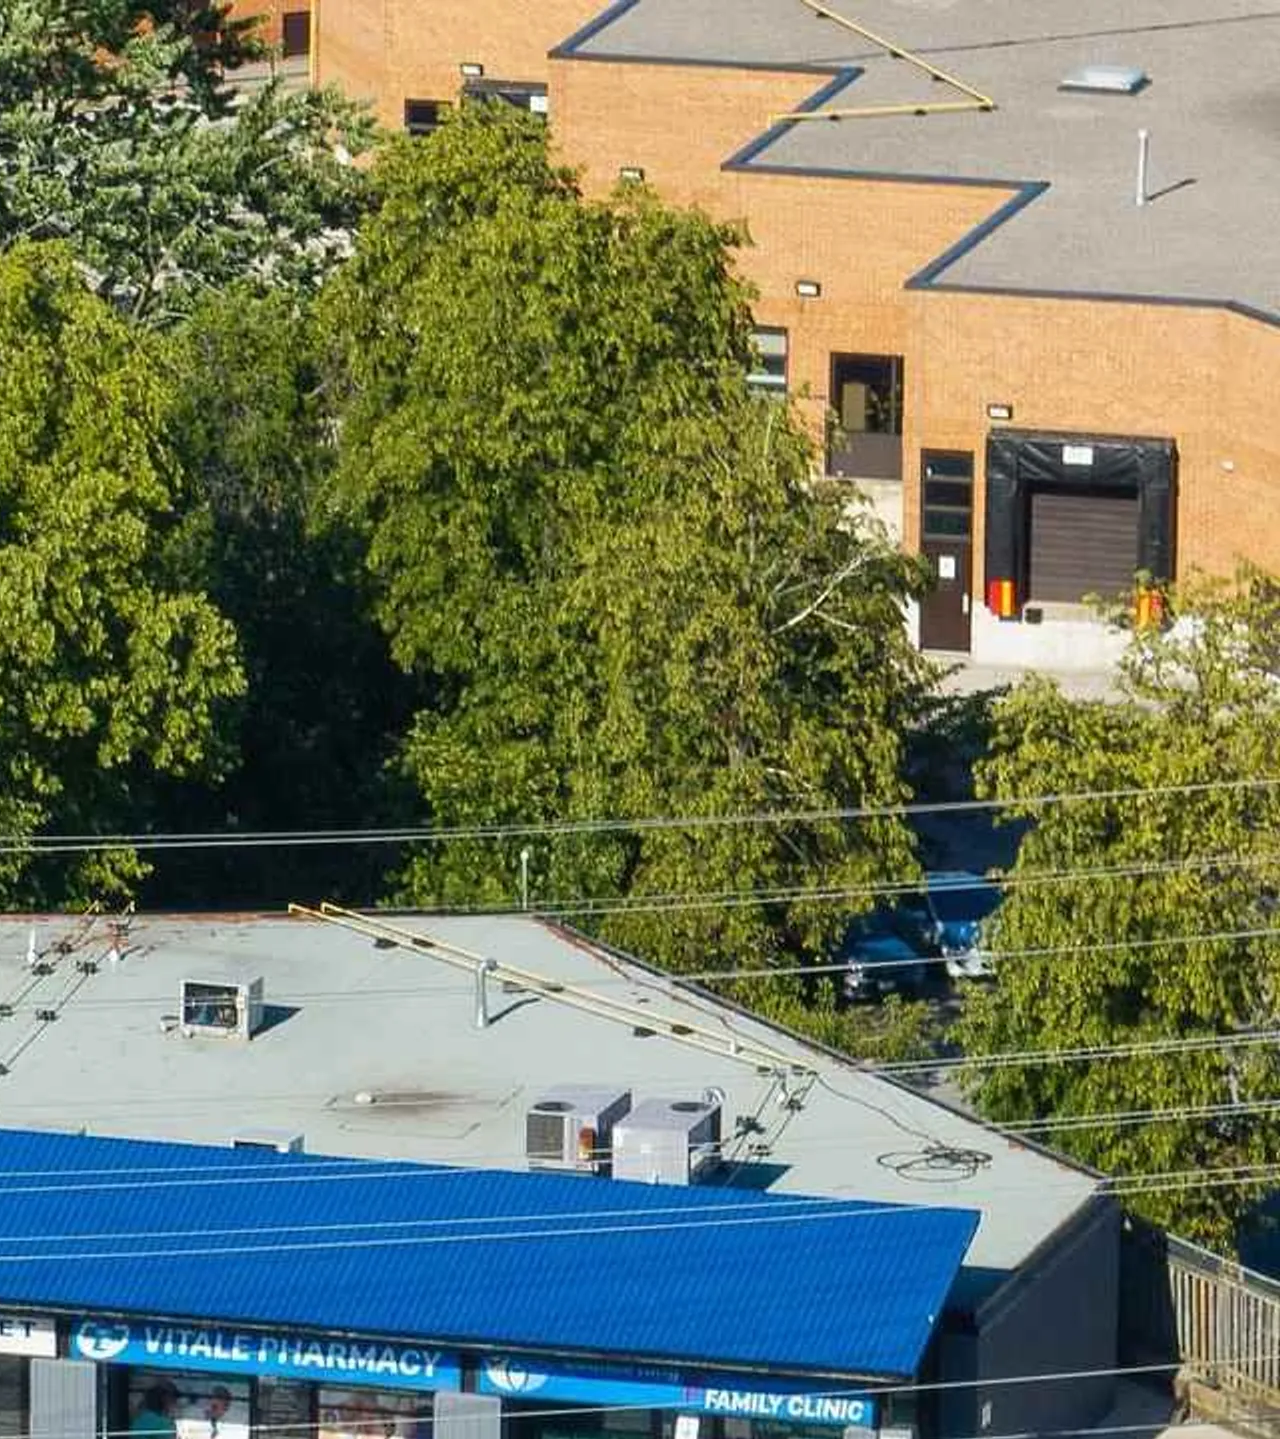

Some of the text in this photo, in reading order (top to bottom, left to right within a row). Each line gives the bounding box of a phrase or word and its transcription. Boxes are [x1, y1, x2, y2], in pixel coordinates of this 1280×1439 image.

[144, 1326, 441, 1378] VITALE PHARMACY
[703, 1388, 864, 1421] FAMILY CLINIC
